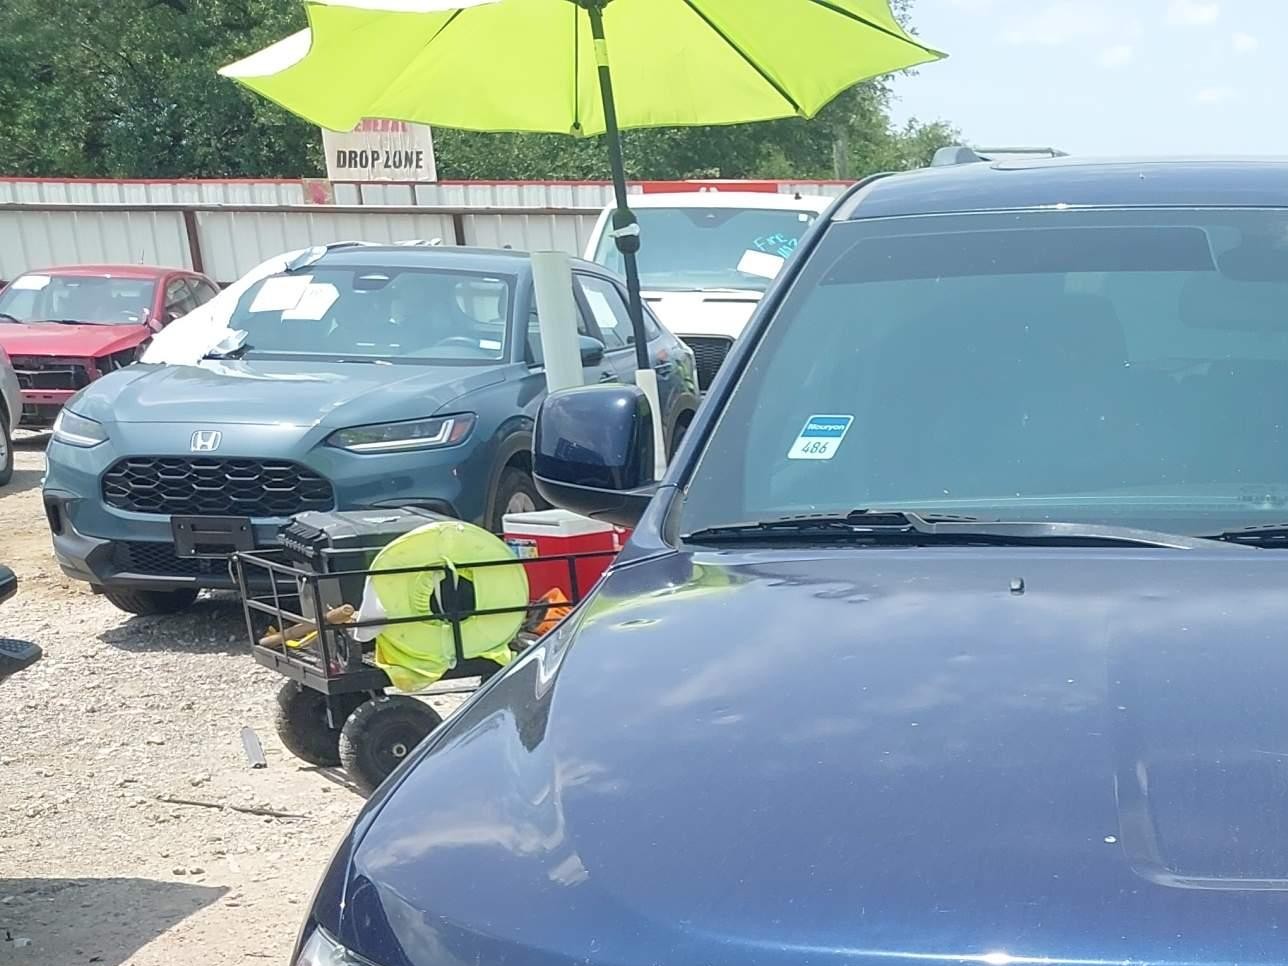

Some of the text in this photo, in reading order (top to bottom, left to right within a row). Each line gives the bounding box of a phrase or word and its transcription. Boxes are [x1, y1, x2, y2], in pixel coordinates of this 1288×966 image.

[336, 149, 424, 169] DROP ZONE
[801, 440, 830, 455] 486
